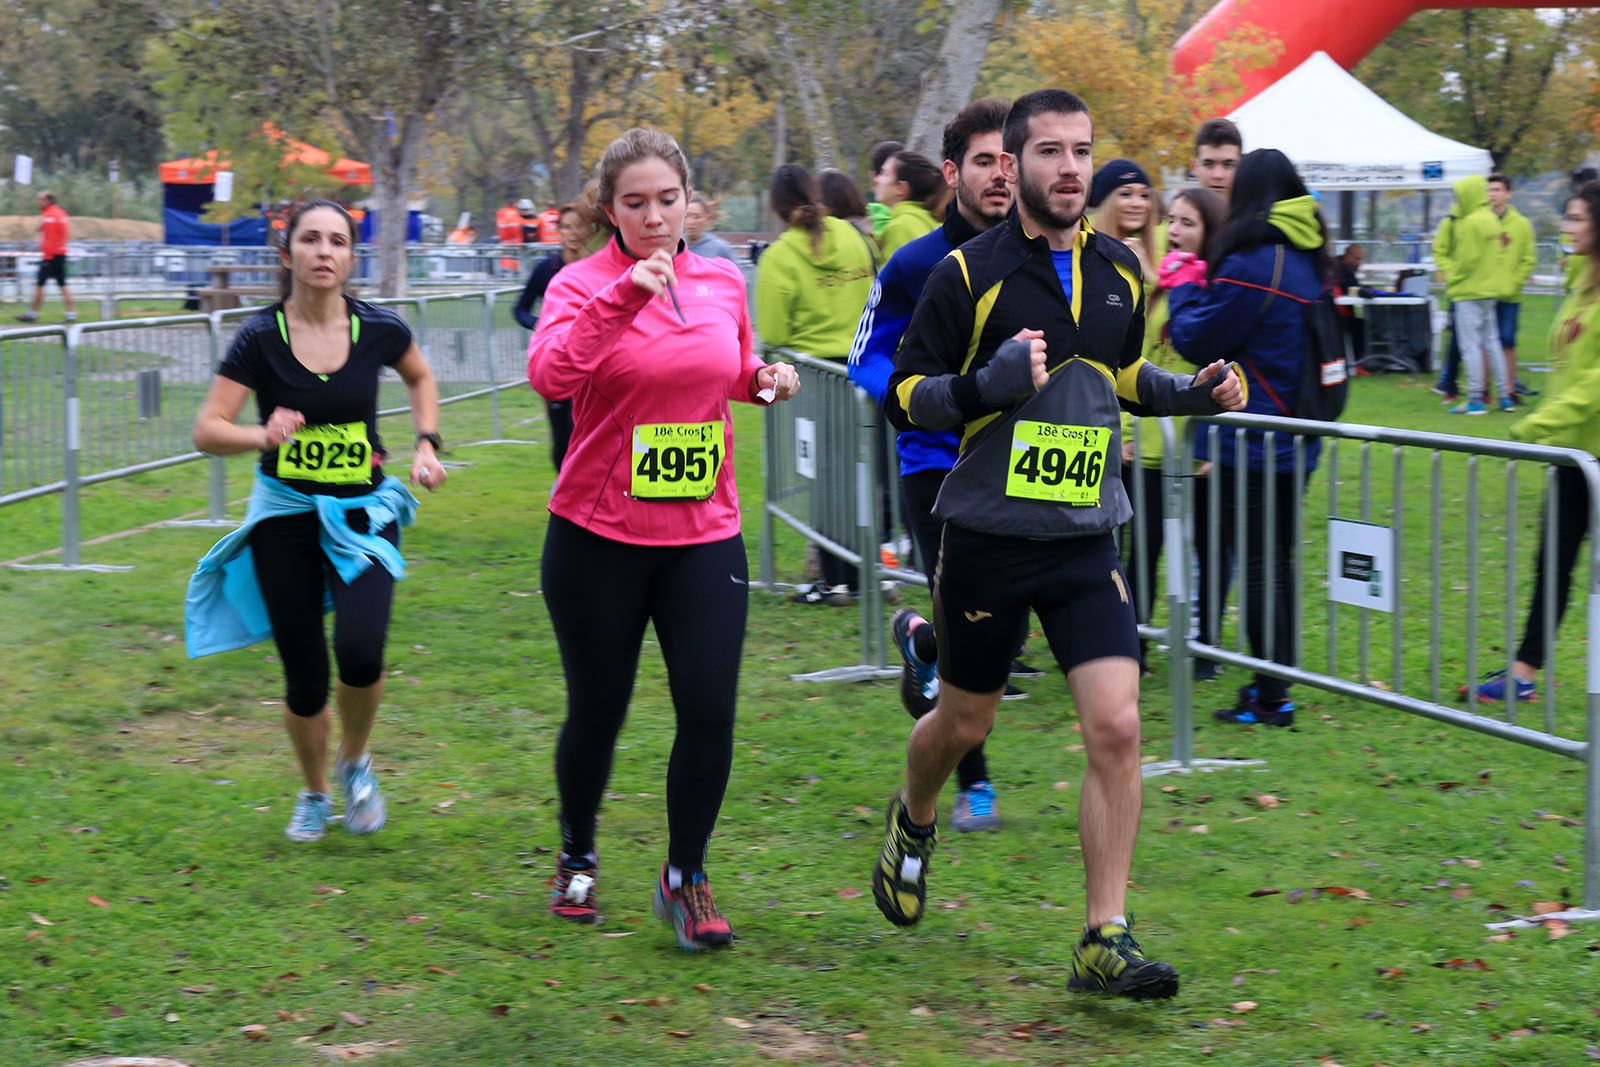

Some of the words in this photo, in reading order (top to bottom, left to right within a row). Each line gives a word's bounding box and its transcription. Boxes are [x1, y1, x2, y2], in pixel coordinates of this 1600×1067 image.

[677, 426, 700, 437] Cros
[1037, 425, 1058, 437] 18è
[1062, 428, 1084, 439] Cros
[285, 440, 366, 470] 4929
[637, 444, 719, 482] 4951
[1014, 446, 1102, 488] 4946
